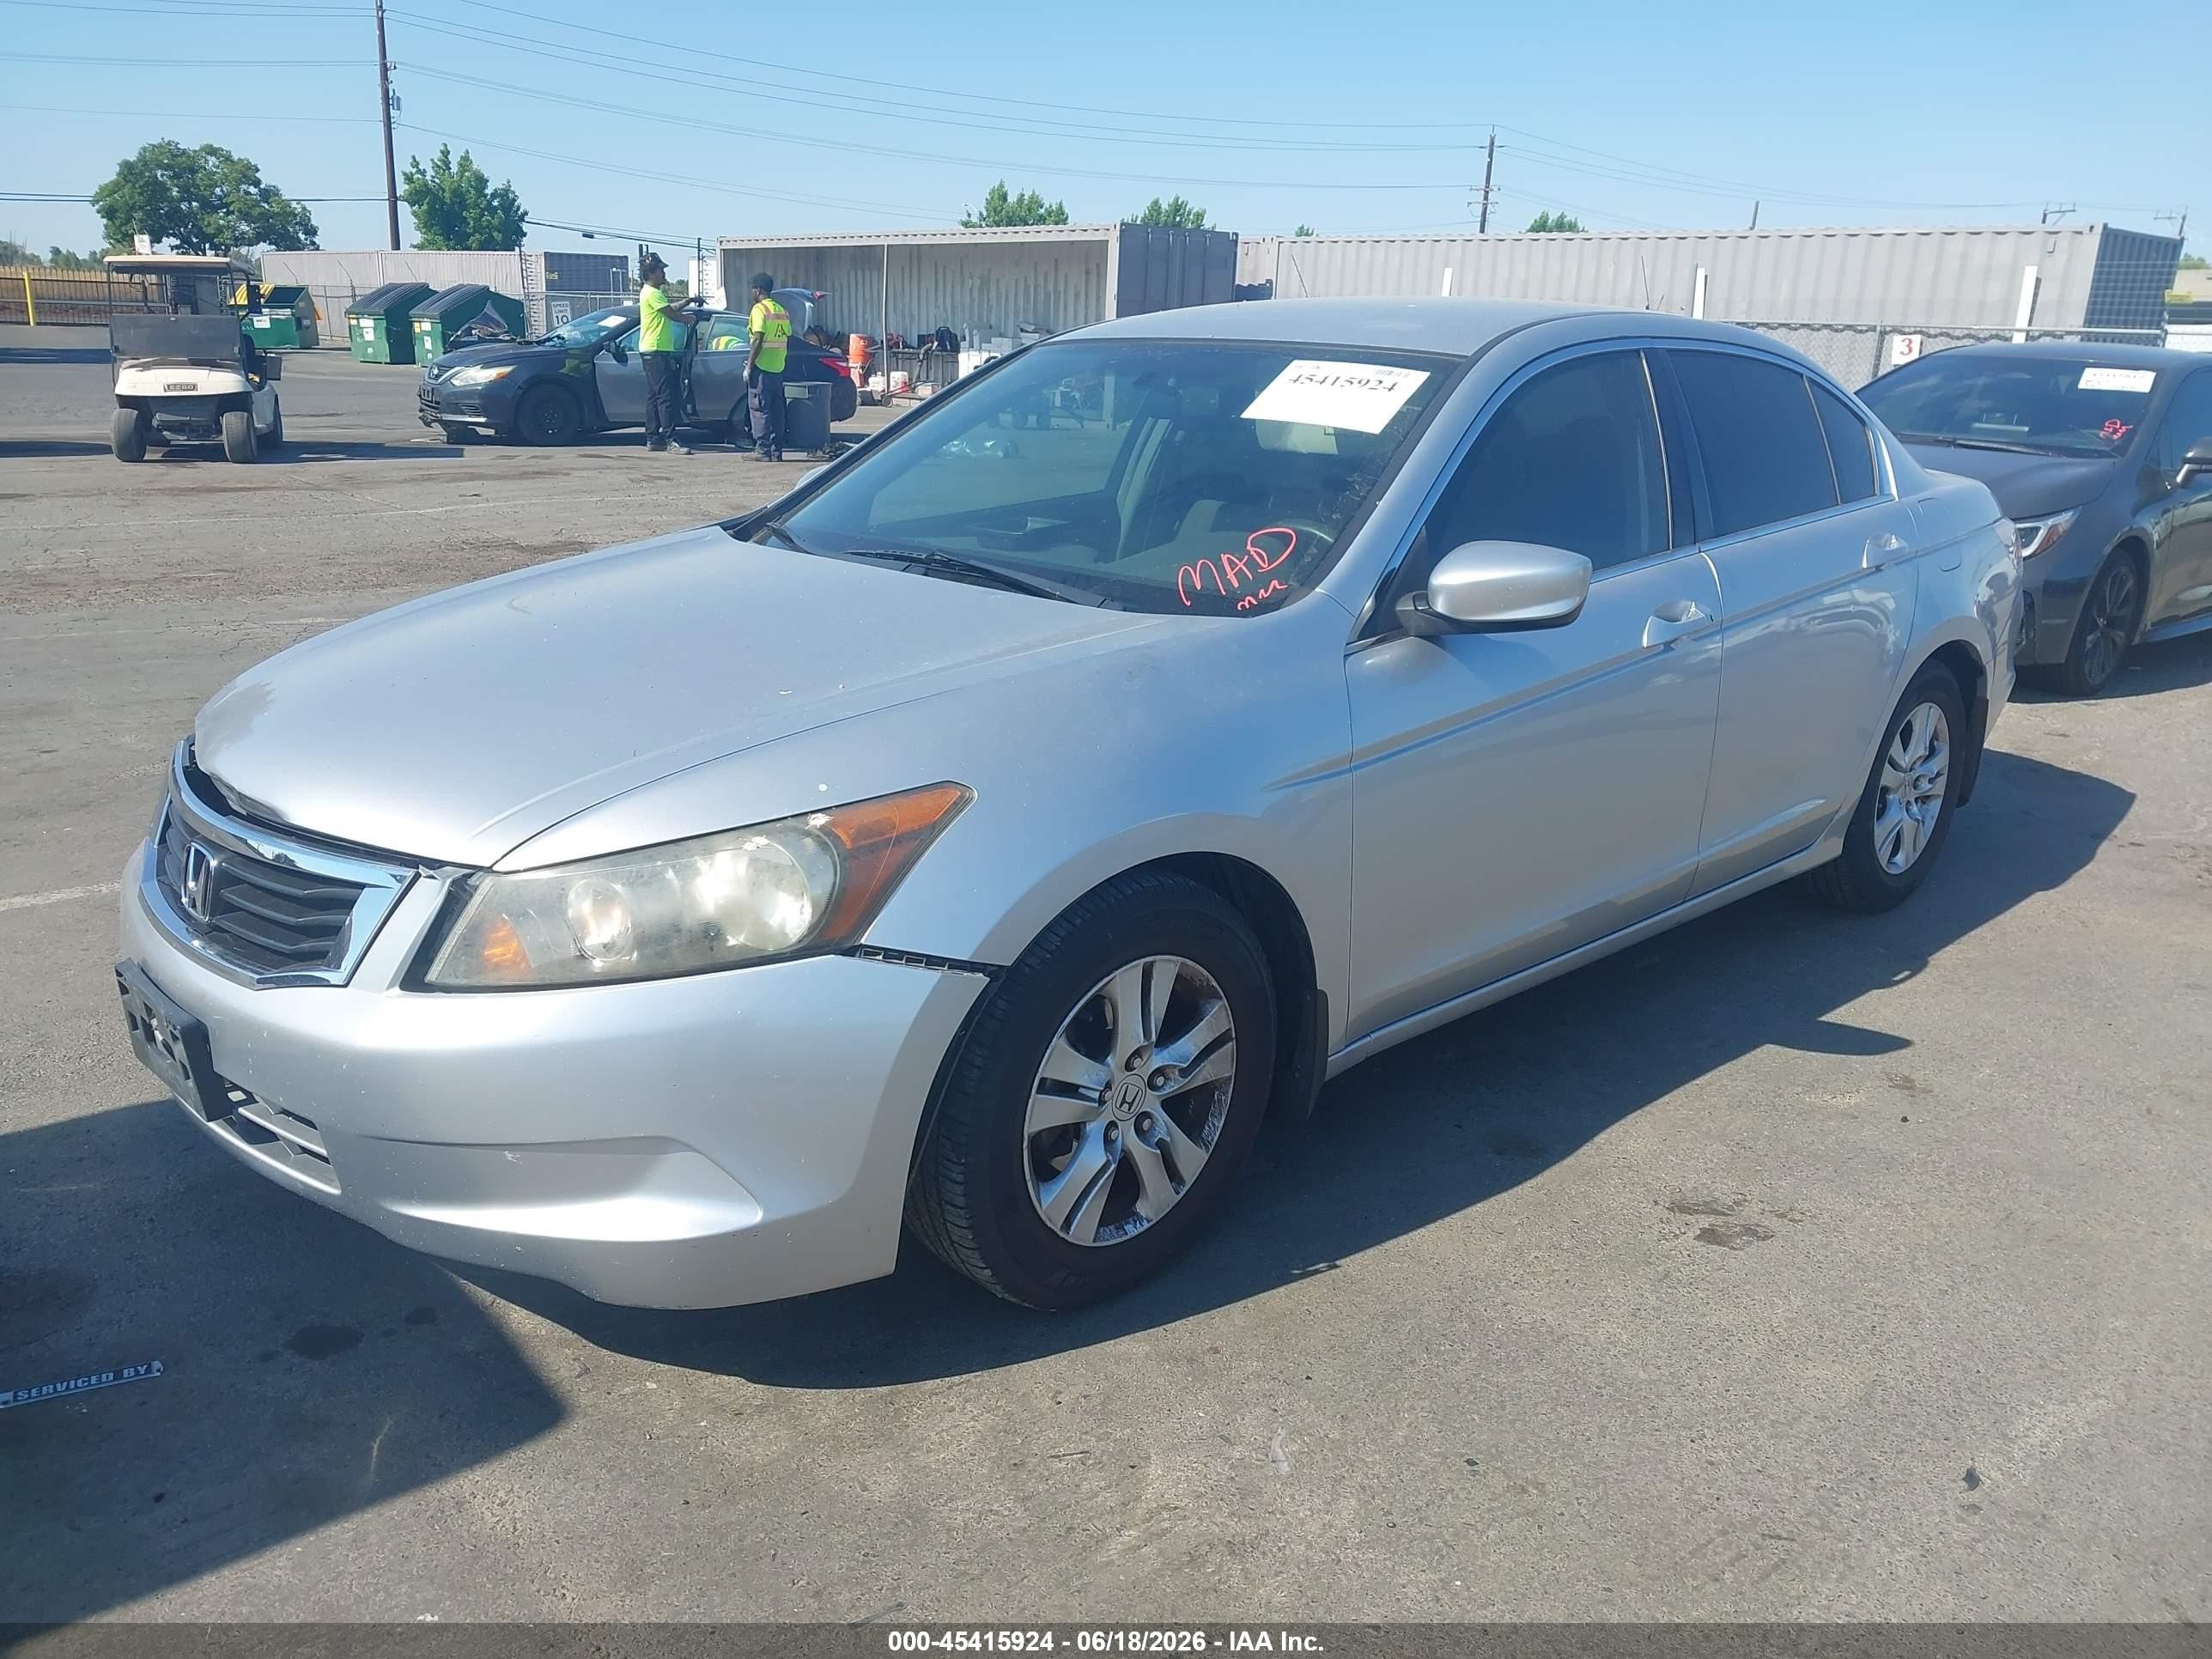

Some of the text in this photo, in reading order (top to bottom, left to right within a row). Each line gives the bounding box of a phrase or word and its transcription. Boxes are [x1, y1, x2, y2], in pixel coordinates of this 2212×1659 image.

[556, 315, 568, 325] 10
[1899, 337, 1913, 356] 3
[1289, 374, 1399, 392] 45415924
[1178, 527, 1297, 606] MAD
[16, 1364, 149, 1401] SERVICED BY
